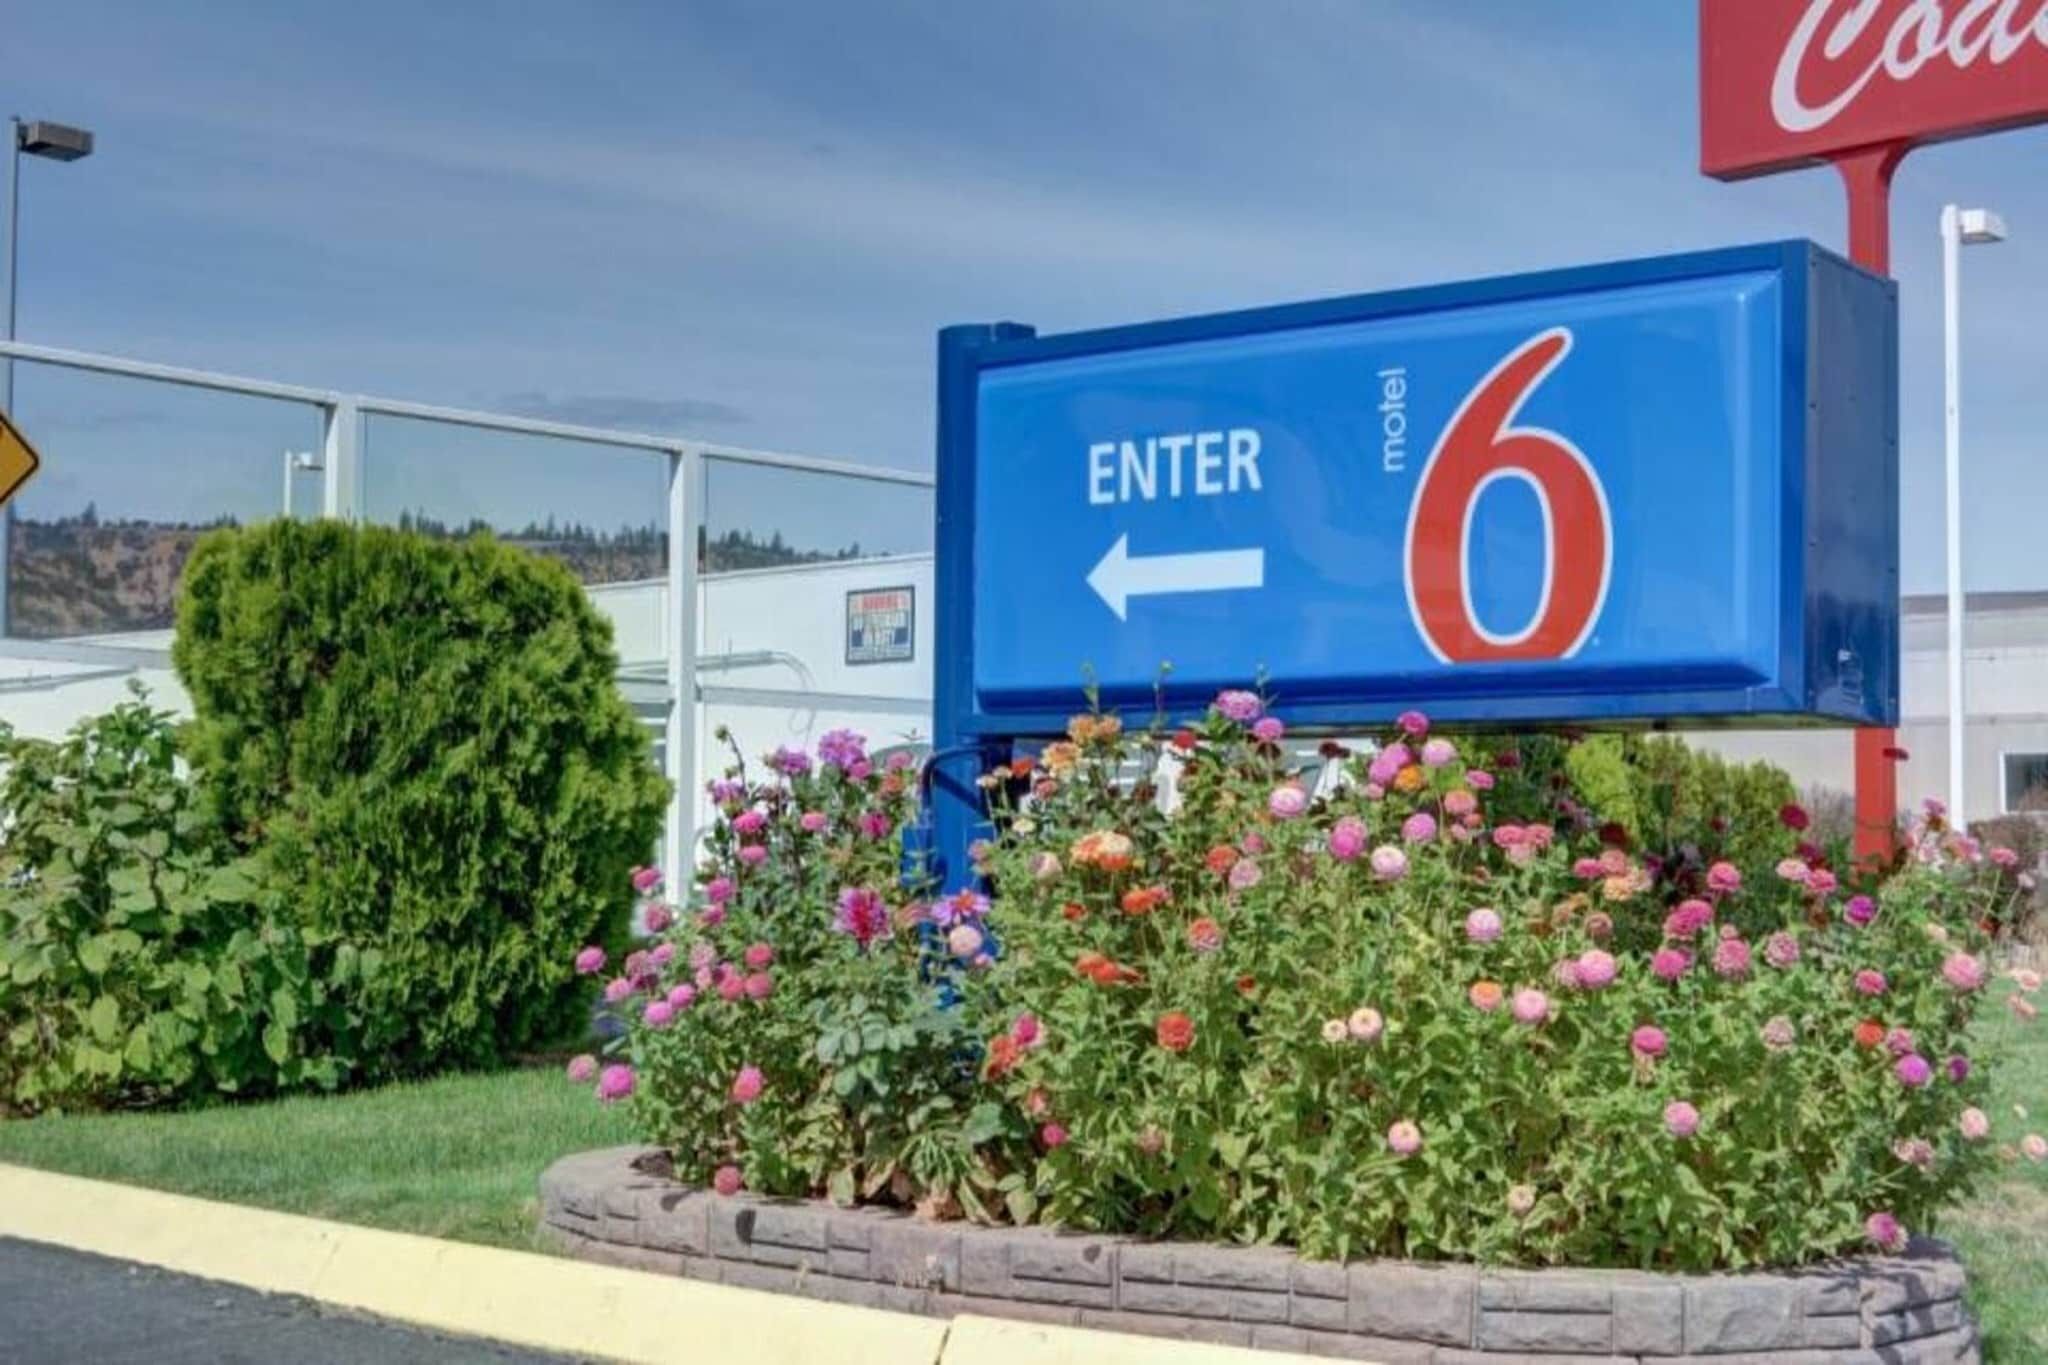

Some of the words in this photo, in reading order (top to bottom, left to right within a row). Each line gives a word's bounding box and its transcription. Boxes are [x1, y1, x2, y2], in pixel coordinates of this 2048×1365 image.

[1771, 0, 2048, 132] Coa
[1088, 428, 1262, 505] ENTER
[1376, 367, 1407, 472] motel
[1403, 327, 1613, 665] 6
